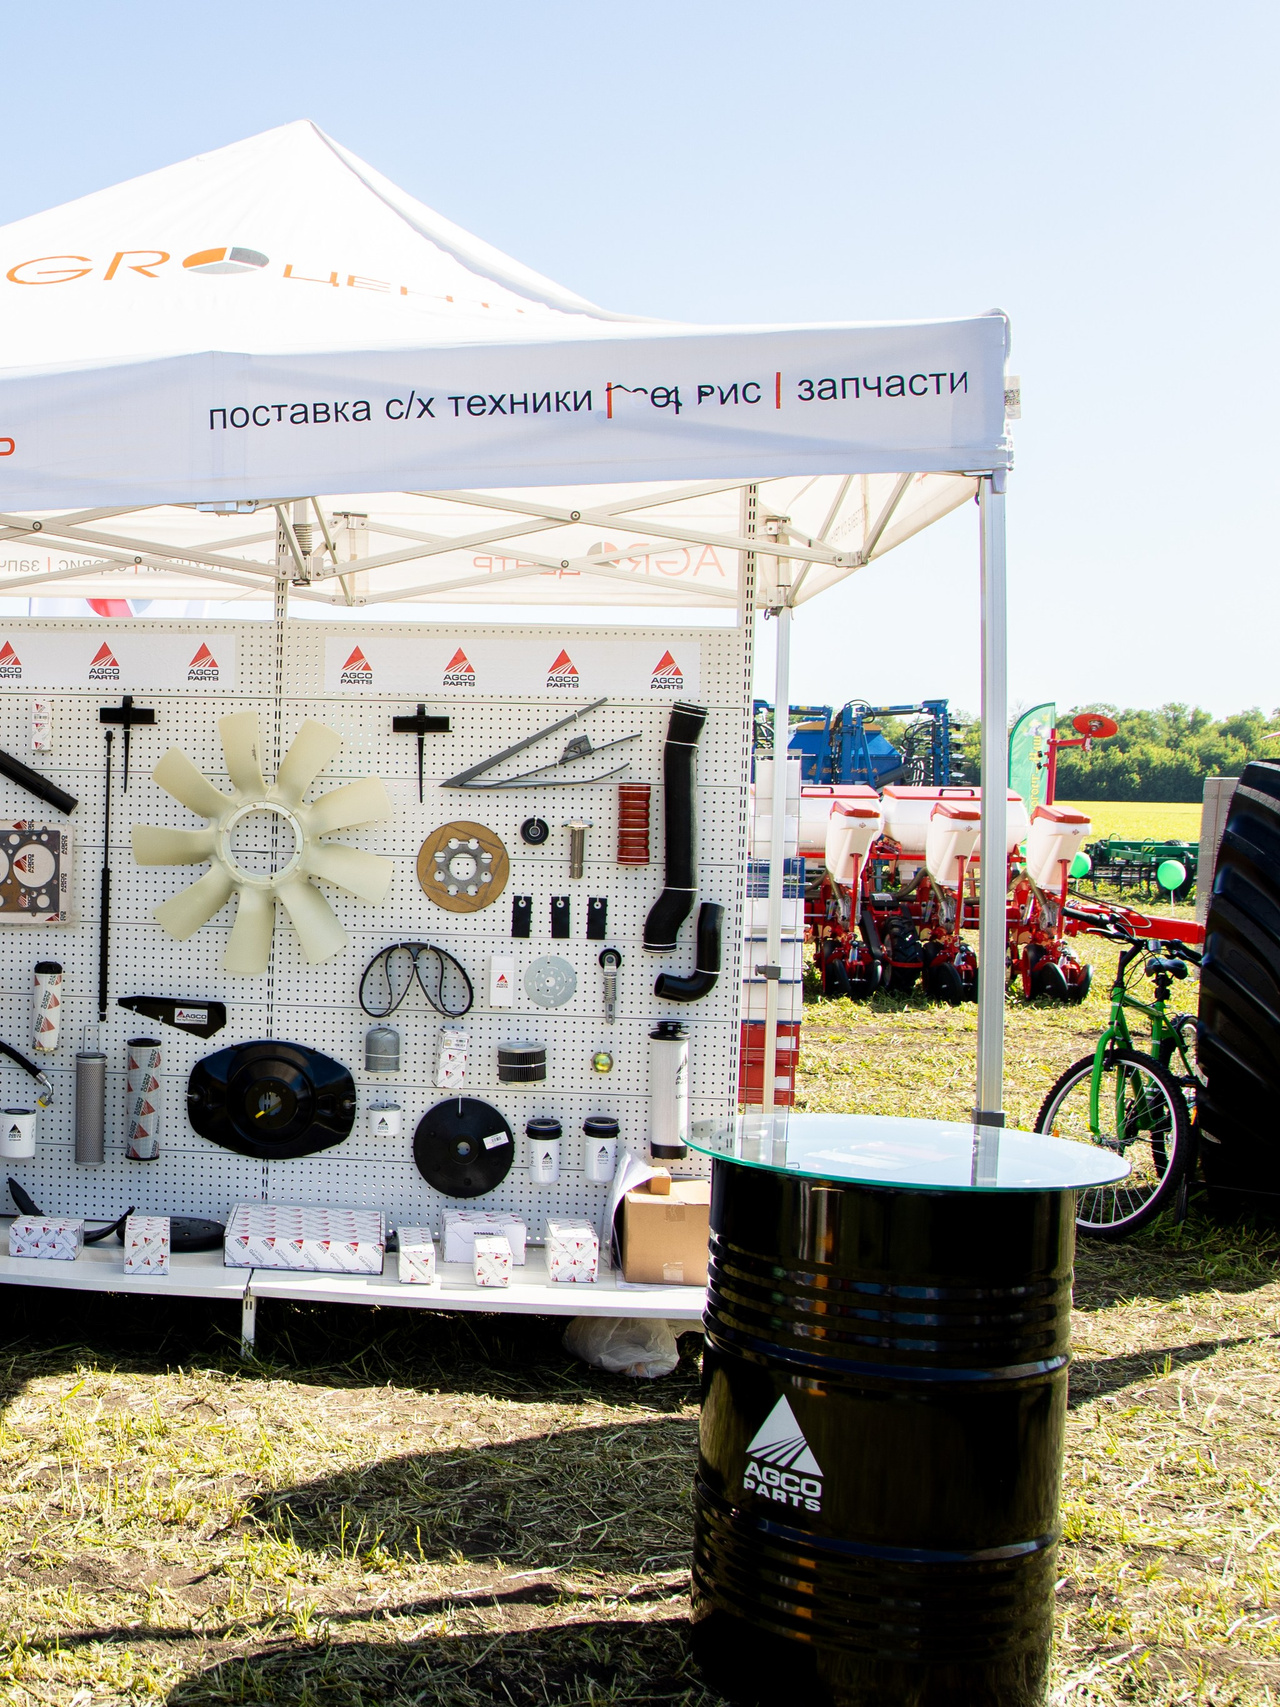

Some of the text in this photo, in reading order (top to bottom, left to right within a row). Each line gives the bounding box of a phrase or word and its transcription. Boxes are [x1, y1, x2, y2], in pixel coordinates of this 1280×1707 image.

[208, 394, 373, 431] поставка
[385, 389, 436, 422] с/х
[448, 386, 593, 419] техники
[796, 369, 969, 402] запчасти
[89, 667, 120, 675] AGCO
[188, 668, 219, 676] AGCO
[341, 672, 373, 680] AGCO
[443, 674, 476, 682] AGCO
[547, 675, 580, 683] AGCO
[651, 677, 684, 685] AGCO
[744, 1461, 822, 1498] AGCO
[743, 1477, 821, 1512] PARTS
